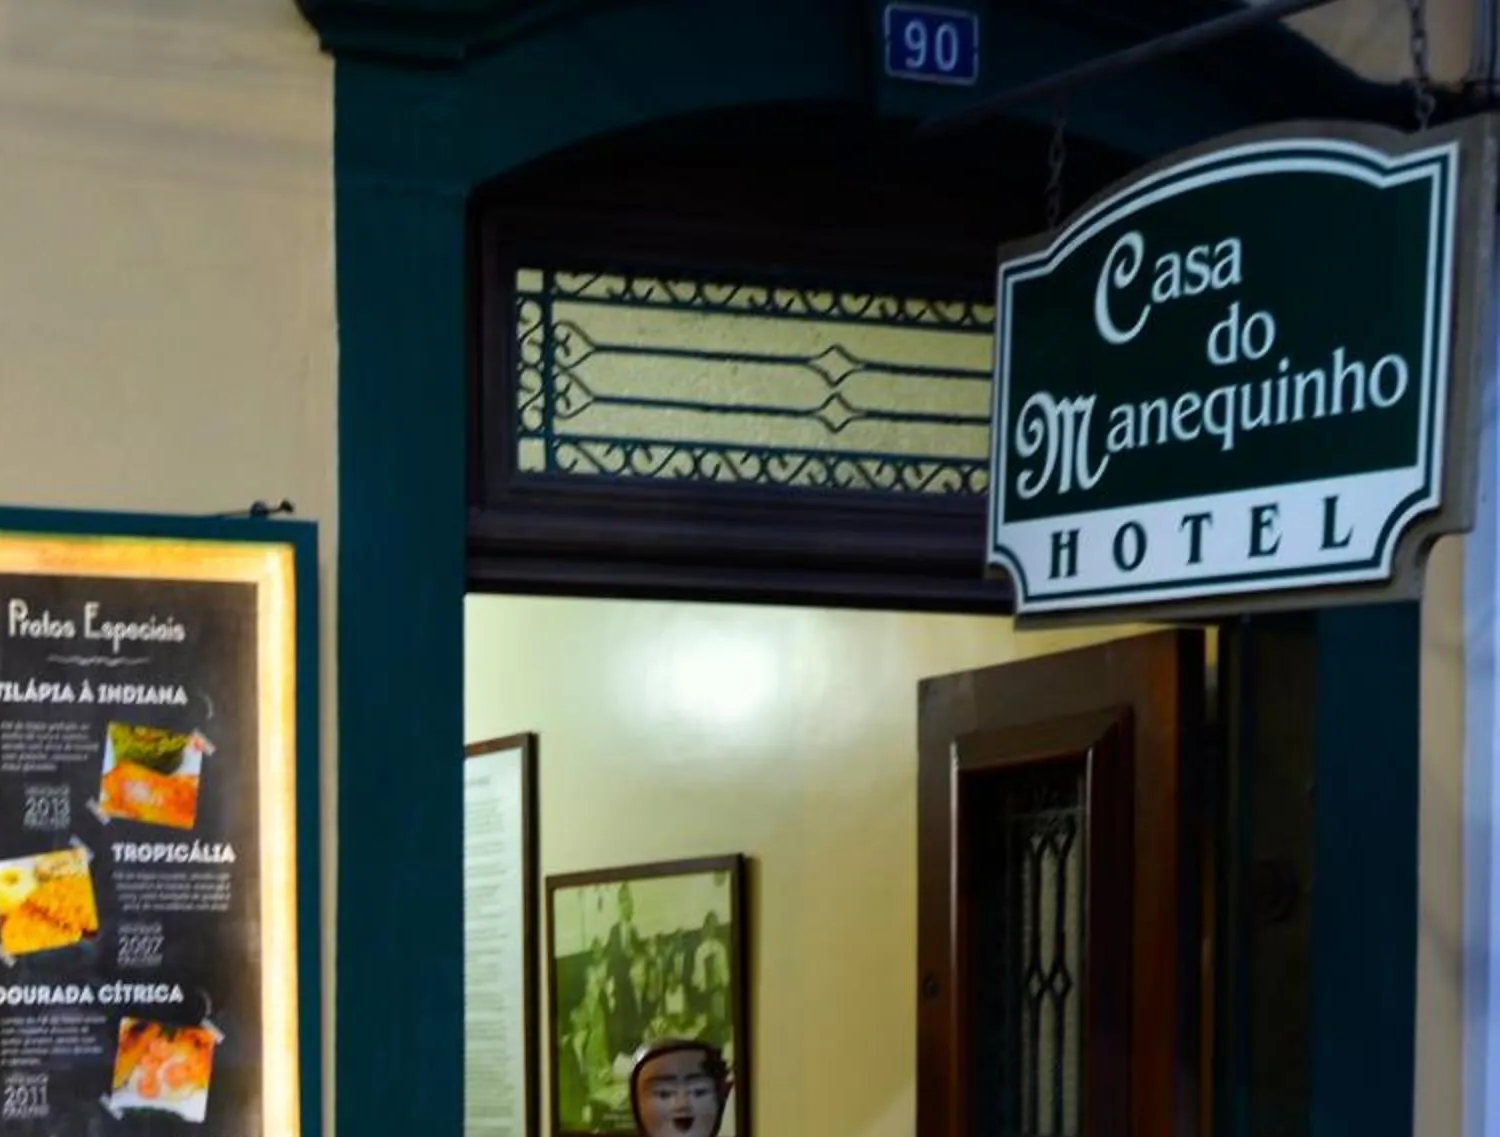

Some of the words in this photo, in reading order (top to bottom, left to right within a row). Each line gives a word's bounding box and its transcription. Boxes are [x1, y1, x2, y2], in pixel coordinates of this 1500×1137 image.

[904, 19, 958, 71] 90
[1094, 231, 1242, 345] Casa
[1206, 301, 1276, 365] do
[1015, 346, 1408, 500] Manequinho
[1048, 495, 1354, 580] HOTEL
[8, 598, 76, 639] Pratos
[84, 602, 187, 653] Especiais
[98, 683, 189, 706] INDIANA
[111, 840, 237, 863] TROPICÁLIA
[97, 979, 185, 1004] CÍTRICA
[4, 1085, 48, 1105] 2011
